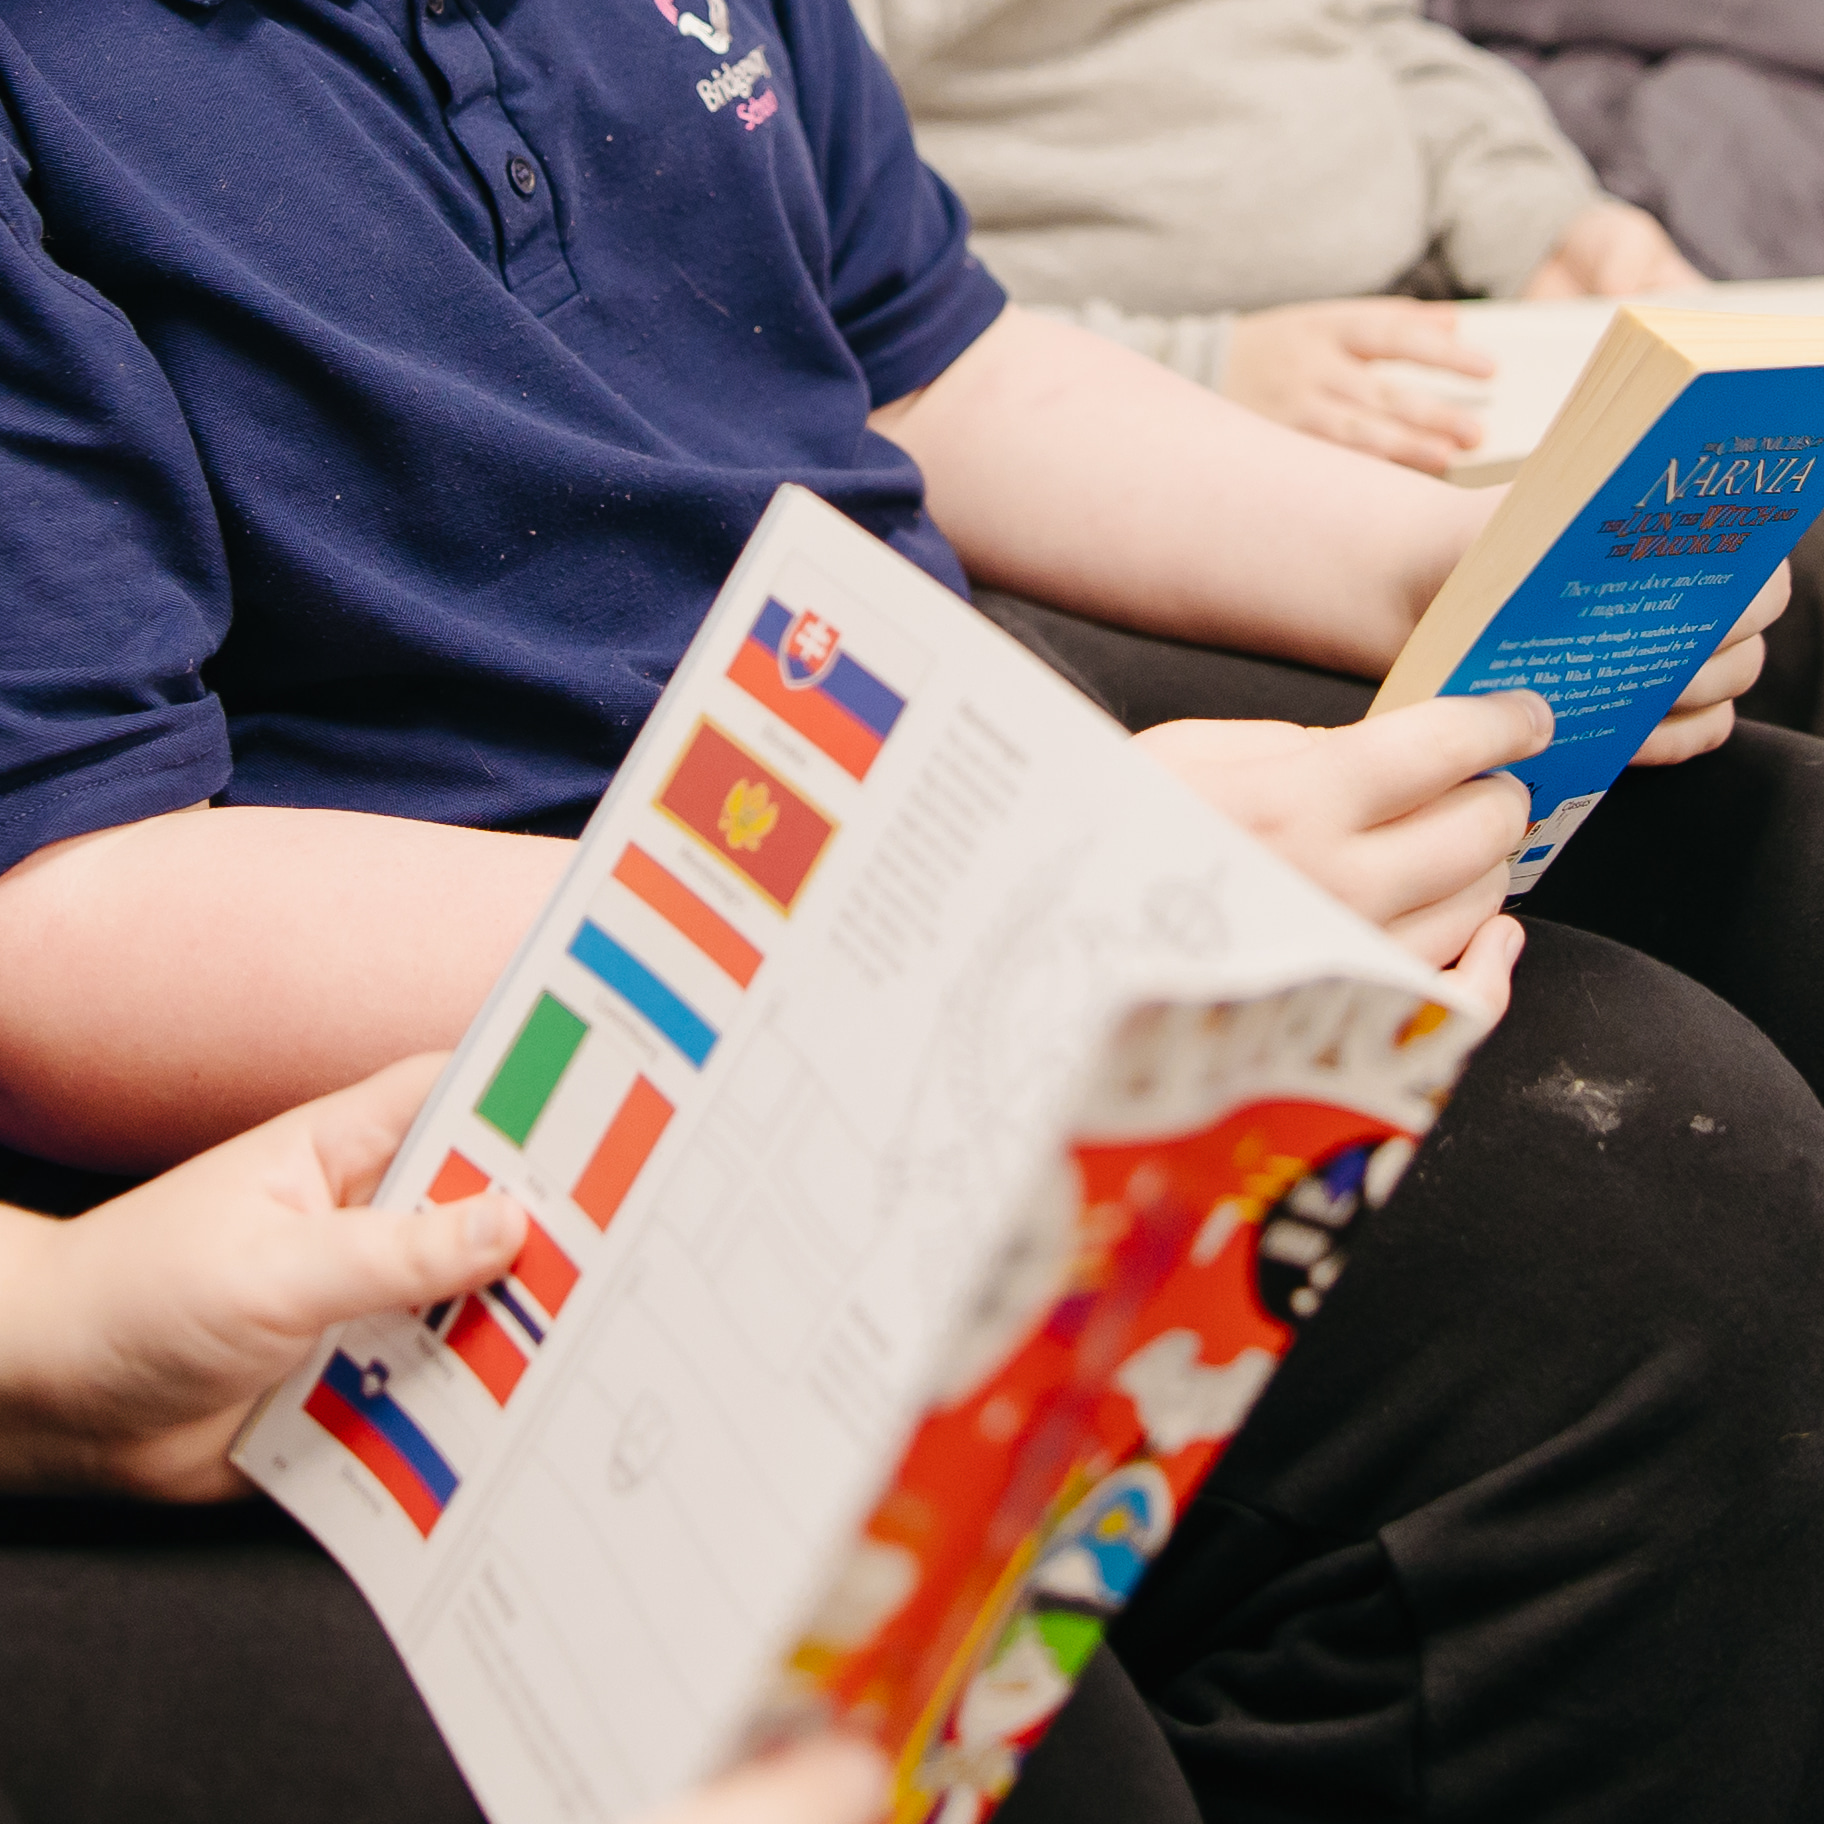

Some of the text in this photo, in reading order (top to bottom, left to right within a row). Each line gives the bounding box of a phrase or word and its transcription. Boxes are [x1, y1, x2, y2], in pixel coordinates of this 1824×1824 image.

[1716, 435, 1810, 456] CHRONICLES
[1634, 455, 1817, 508] NARNIA
[1699, 504, 1775, 531] WITCH
[1628, 532, 1752, 562] WARDROBE
[1560, 580, 1591, 598] They
[1593, 581, 1626, 598] open
[1640, 573, 1671, 590] door
[1671, 570, 1703, 588] and
[1697, 573, 1734, 585] enter
[1589, 596, 1645, 618] magical
[1643, 592, 1684, 612] world
[1576, 635, 1596, 646] step
[1596, 628, 1632, 643] through
[1639, 624, 1679, 637] wardrobe
[1678, 622, 1699, 633] door
[1697, 619, 1718, 631] and
[1526, 652, 1552, 666] land
[1561, 651, 1594, 663] Narnia
[1611, 645, 1638, 658] world
[1636, 640, 1674, 656] enslaved
[1683, 638, 1698, 649] the
[1533, 672, 1562, 683] White
[1596, 666, 1621, 679] When
[1620, 663, 1650, 675] almost
[1648, 658, 1664, 670] all
[1661, 657, 1682, 669] hope
[1564, 688, 1590, 701] Great
